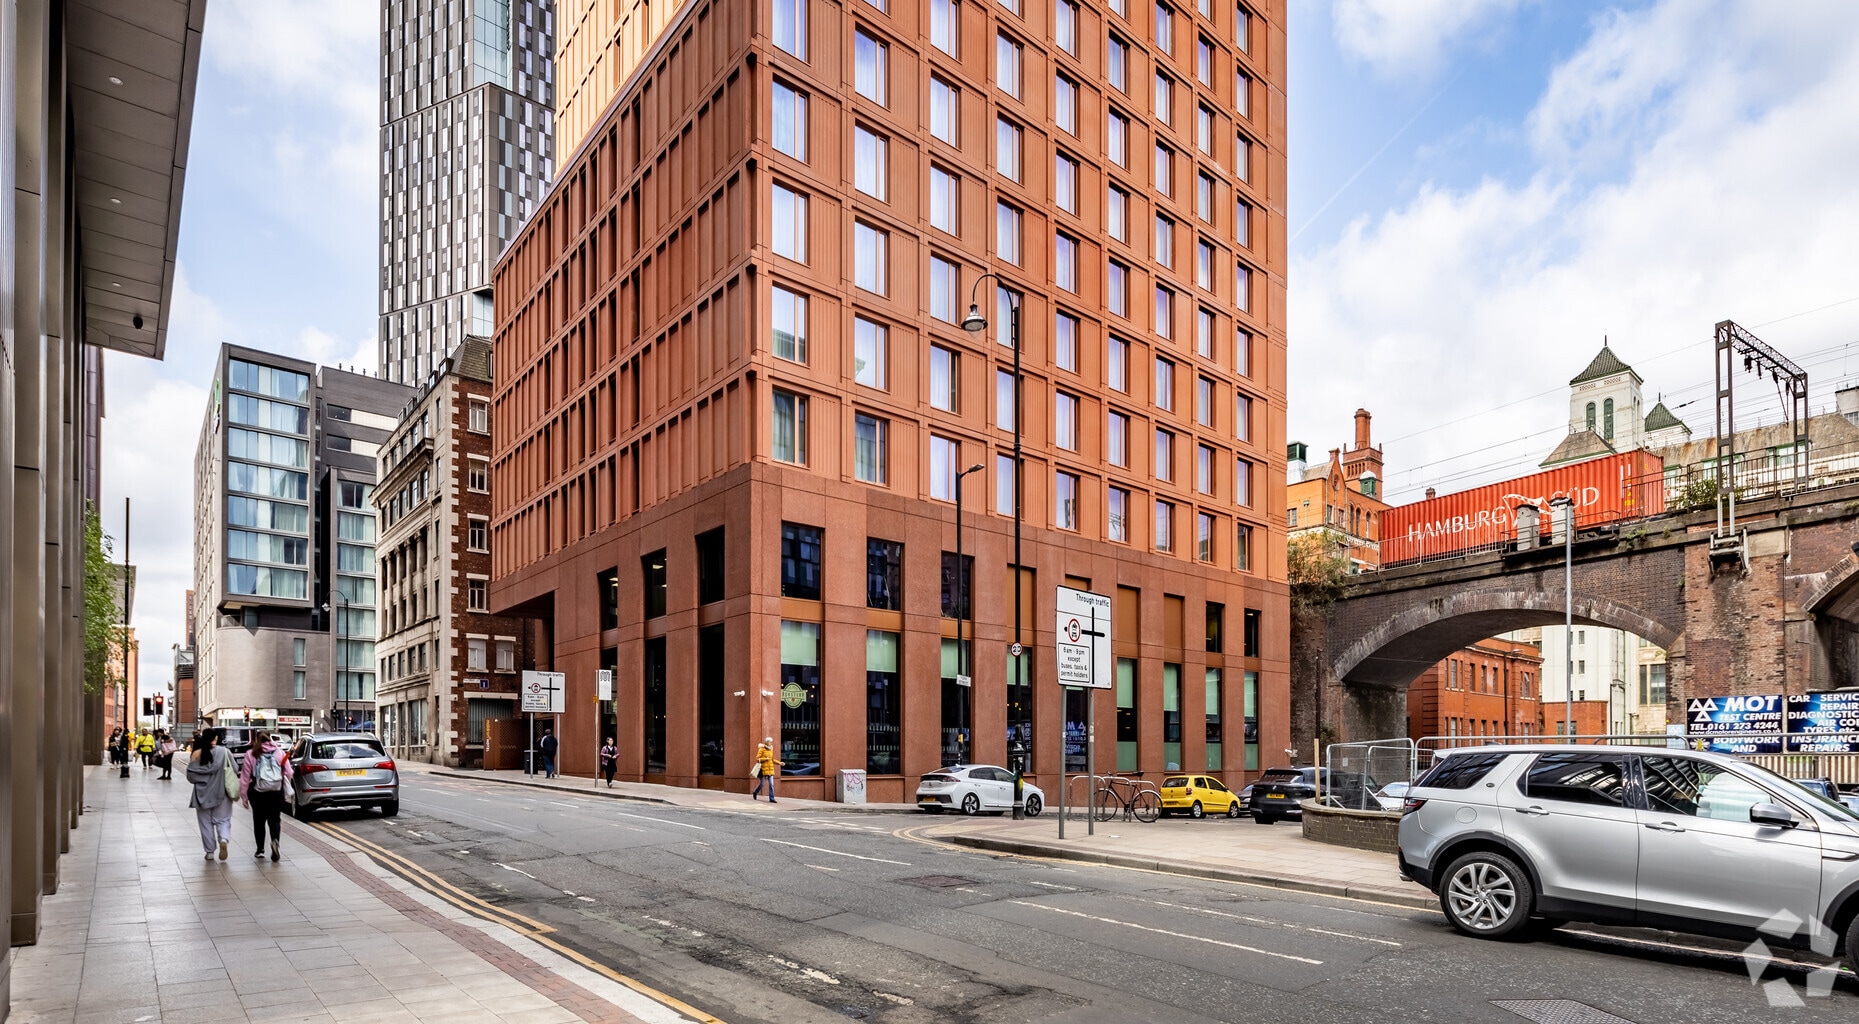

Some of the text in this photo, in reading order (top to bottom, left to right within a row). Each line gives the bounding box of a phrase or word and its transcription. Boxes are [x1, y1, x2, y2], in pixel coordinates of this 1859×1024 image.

[1408, 506, 1506, 542] HAMBURG
[1076, 593, 1110, 608] Through traffic
[1013, 645, 1022, 653] 20
[1067, 656, 1081, 664] except
[1061, 670, 1088, 679] permit holders
[1724, 695, 1779, 712] MOT
[1788, 695, 1811, 703] CAR
[1719, 712, 1782, 722] TEST CENTRE
[1733, 722, 1752, 730] 273
[1752, 721, 1778, 730] 4244
[1817, 719, 1837, 727] AIR
[1731, 744, 1758, 753] AND
[1800, 744, 1851, 752] REPAIRS
